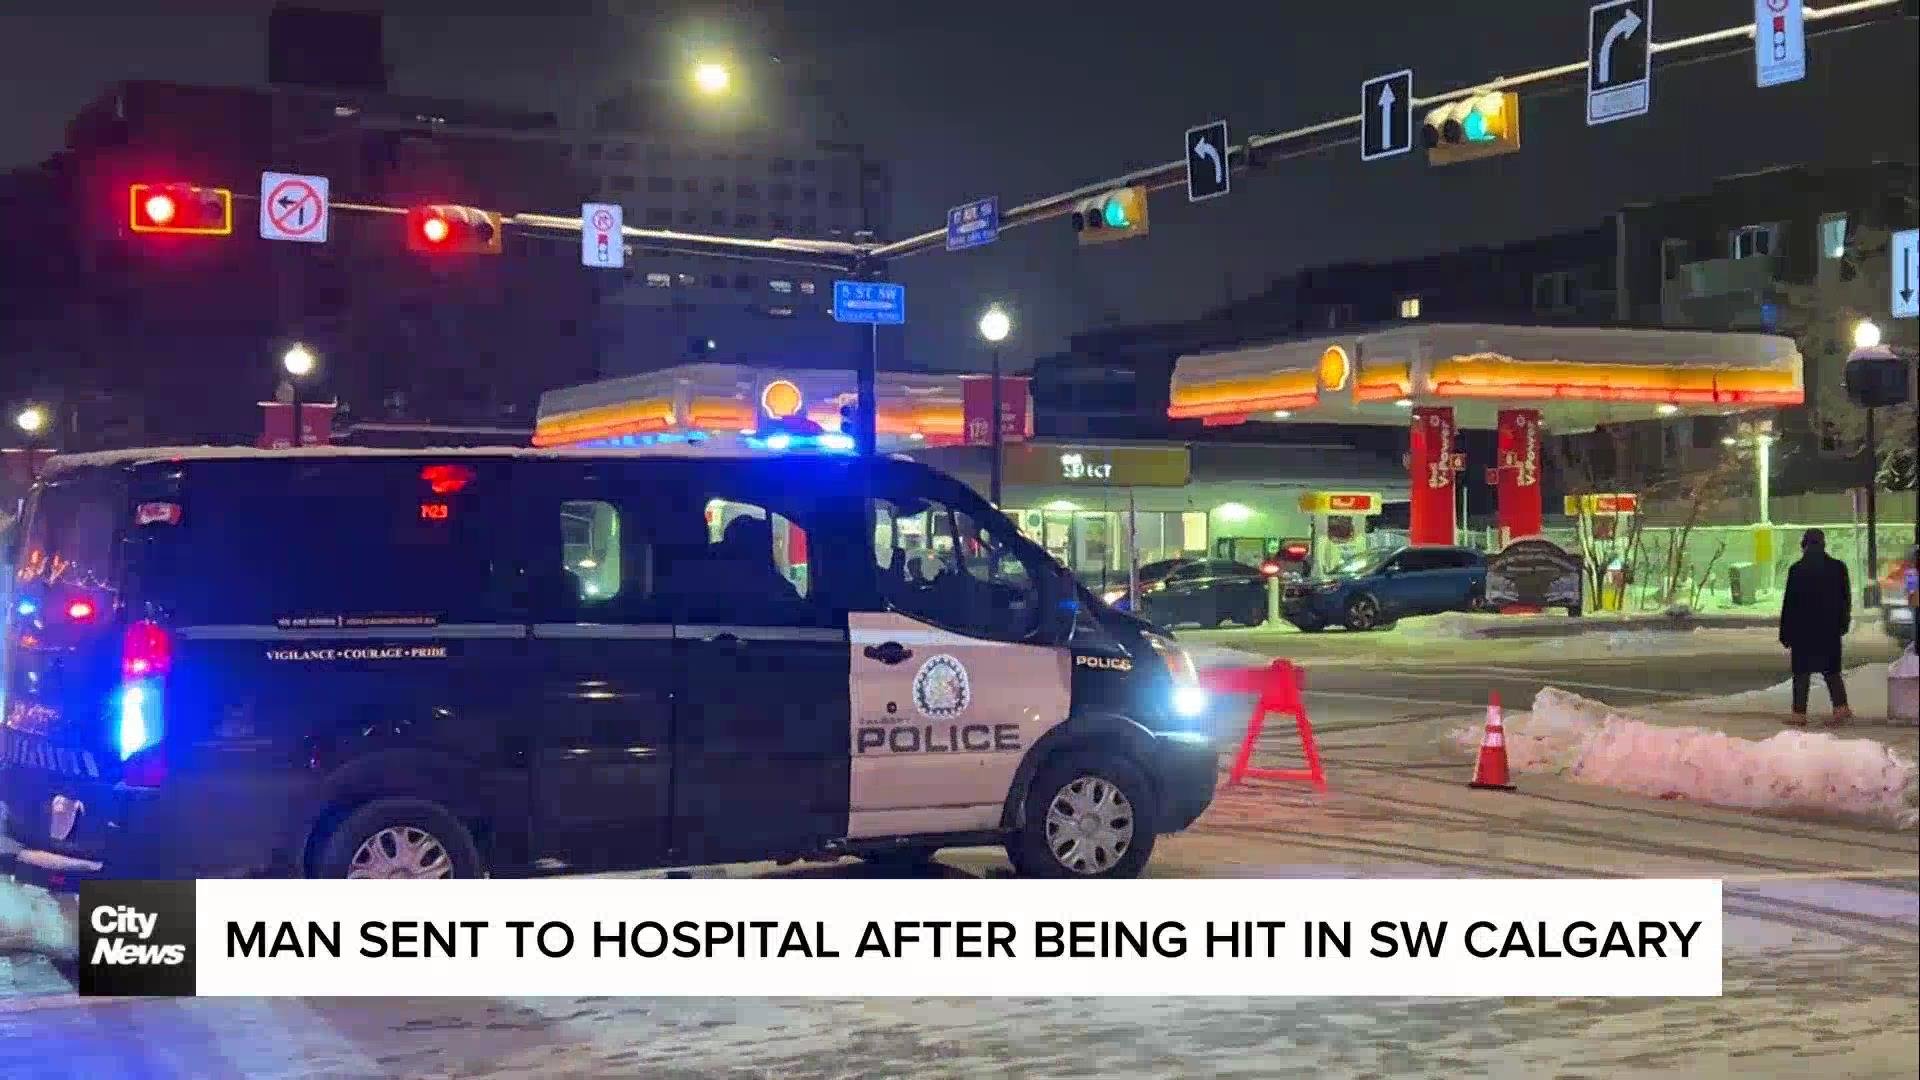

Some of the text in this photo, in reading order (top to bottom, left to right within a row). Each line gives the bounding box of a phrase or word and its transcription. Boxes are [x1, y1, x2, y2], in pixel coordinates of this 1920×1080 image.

[266, 646, 447, 661] VIGILANCE COURAGE PRIDE
[857, 723, 1021, 753] POLICE
